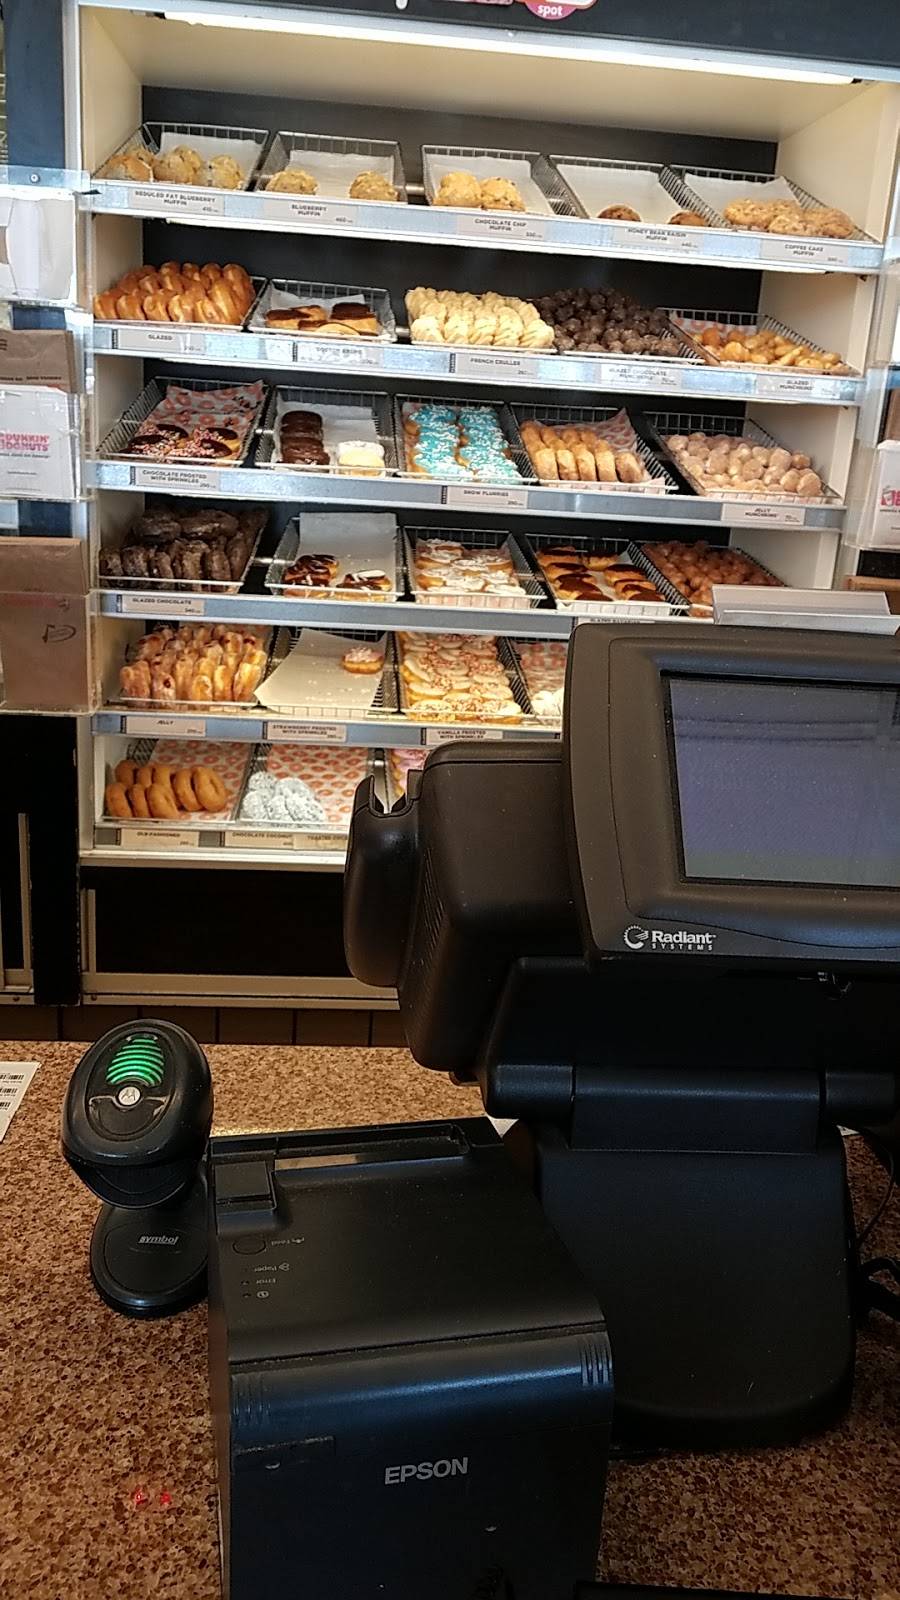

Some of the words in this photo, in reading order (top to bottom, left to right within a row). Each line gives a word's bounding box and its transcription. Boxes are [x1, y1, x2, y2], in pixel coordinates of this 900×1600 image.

[537, 5, 563, 18] spot
[474, 218, 511, 226] CHOCOLATE
[142, 469, 178, 477] CHOCOLATE
[651, 930, 713, 944] Radiant
[651, 943, 713, 951] SYSTEMS
[385, 1457, 469, 1485] EPSON
